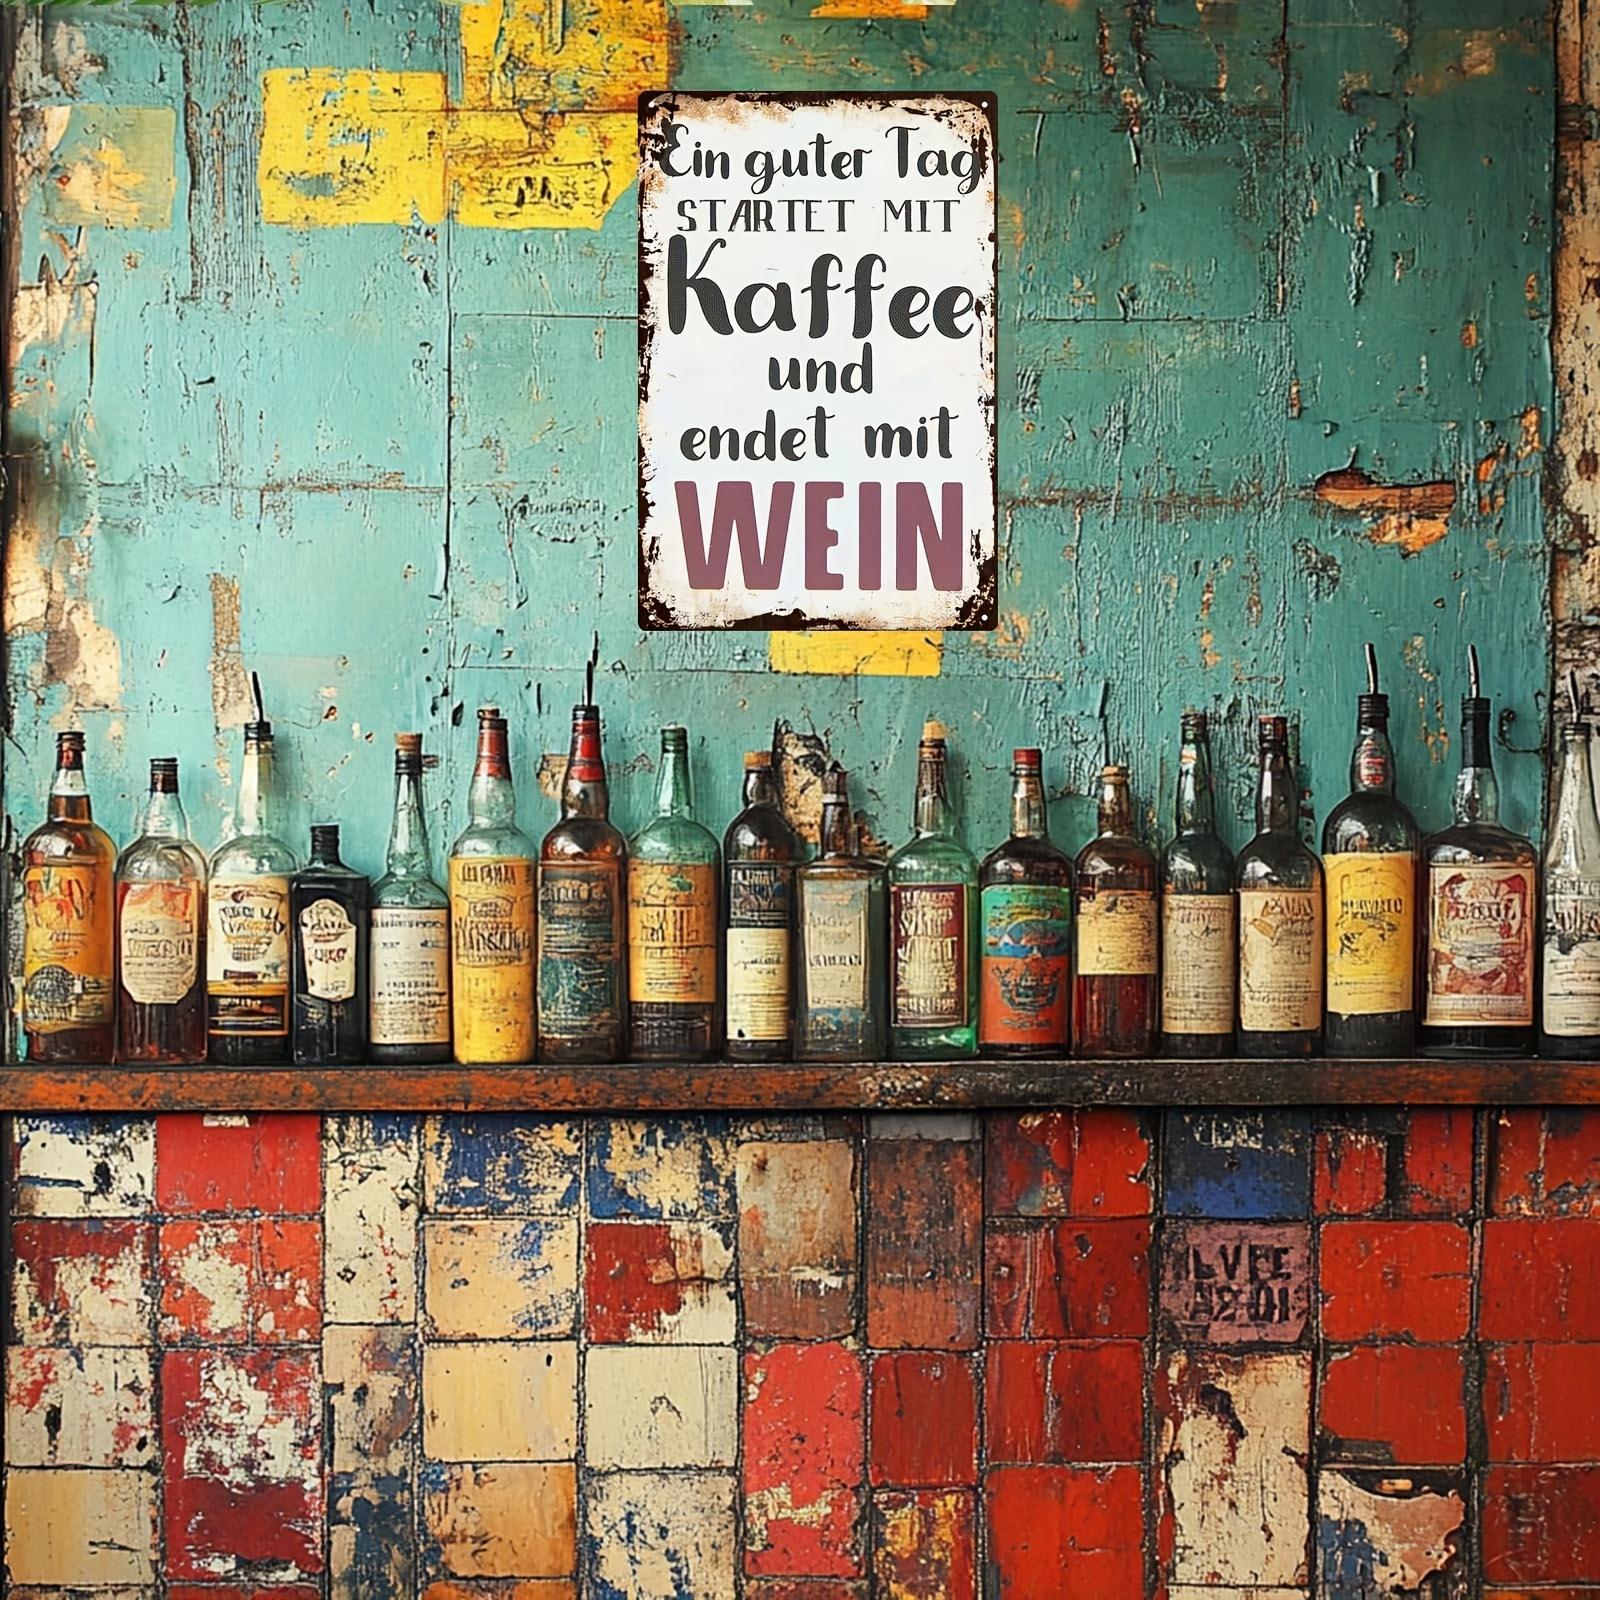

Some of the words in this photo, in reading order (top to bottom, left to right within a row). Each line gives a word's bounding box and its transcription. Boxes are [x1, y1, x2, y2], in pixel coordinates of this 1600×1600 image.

[660, 122, 730, 179] Ein
[745, 133, 873, 195] guter
[885, 126, 982, 195] Tag
[677, 199, 855, 232] STARTET
[883, 199, 961, 232] MIT
[667, 234, 975, 339] Kaffee
[768, 341, 873, 394] und
[679, 405, 836, 461] endet
[864, 406, 959, 459] mit
[674, 480, 964, 591] WEIN
